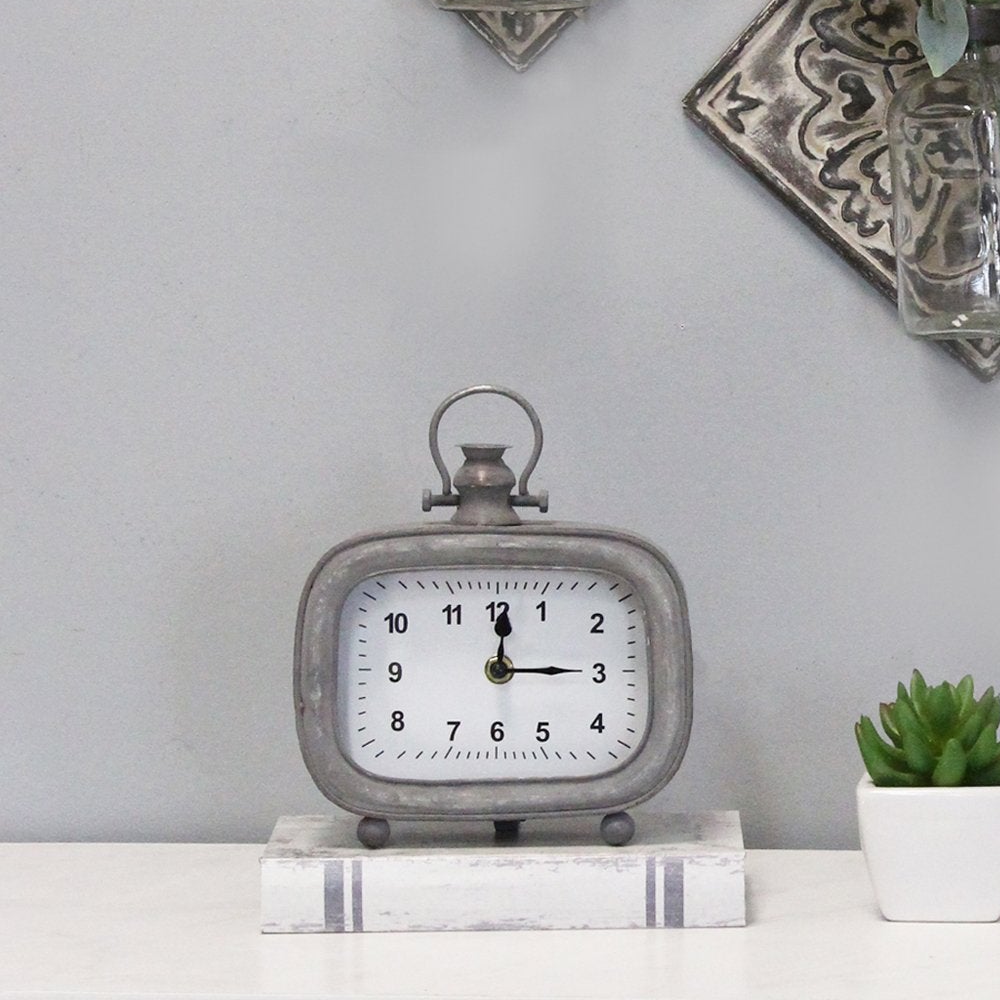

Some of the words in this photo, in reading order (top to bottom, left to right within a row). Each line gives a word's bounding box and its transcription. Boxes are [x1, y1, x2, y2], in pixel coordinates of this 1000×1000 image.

[441, 604, 462, 625] 11
[535, 600, 546, 622] 1
[383, 612, 409, 634] 10
[590, 612, 605, 634] 2
[388, 661, 403, 683] 9
[592, 662, 607, 684] 3
[390, 710, 405, 732] 8
[446, 721, 461, 742] 7
[490, 721, 505, 742] 6
[535, 721, 550, 743] 5
[589, 712, 606, 734] 4
